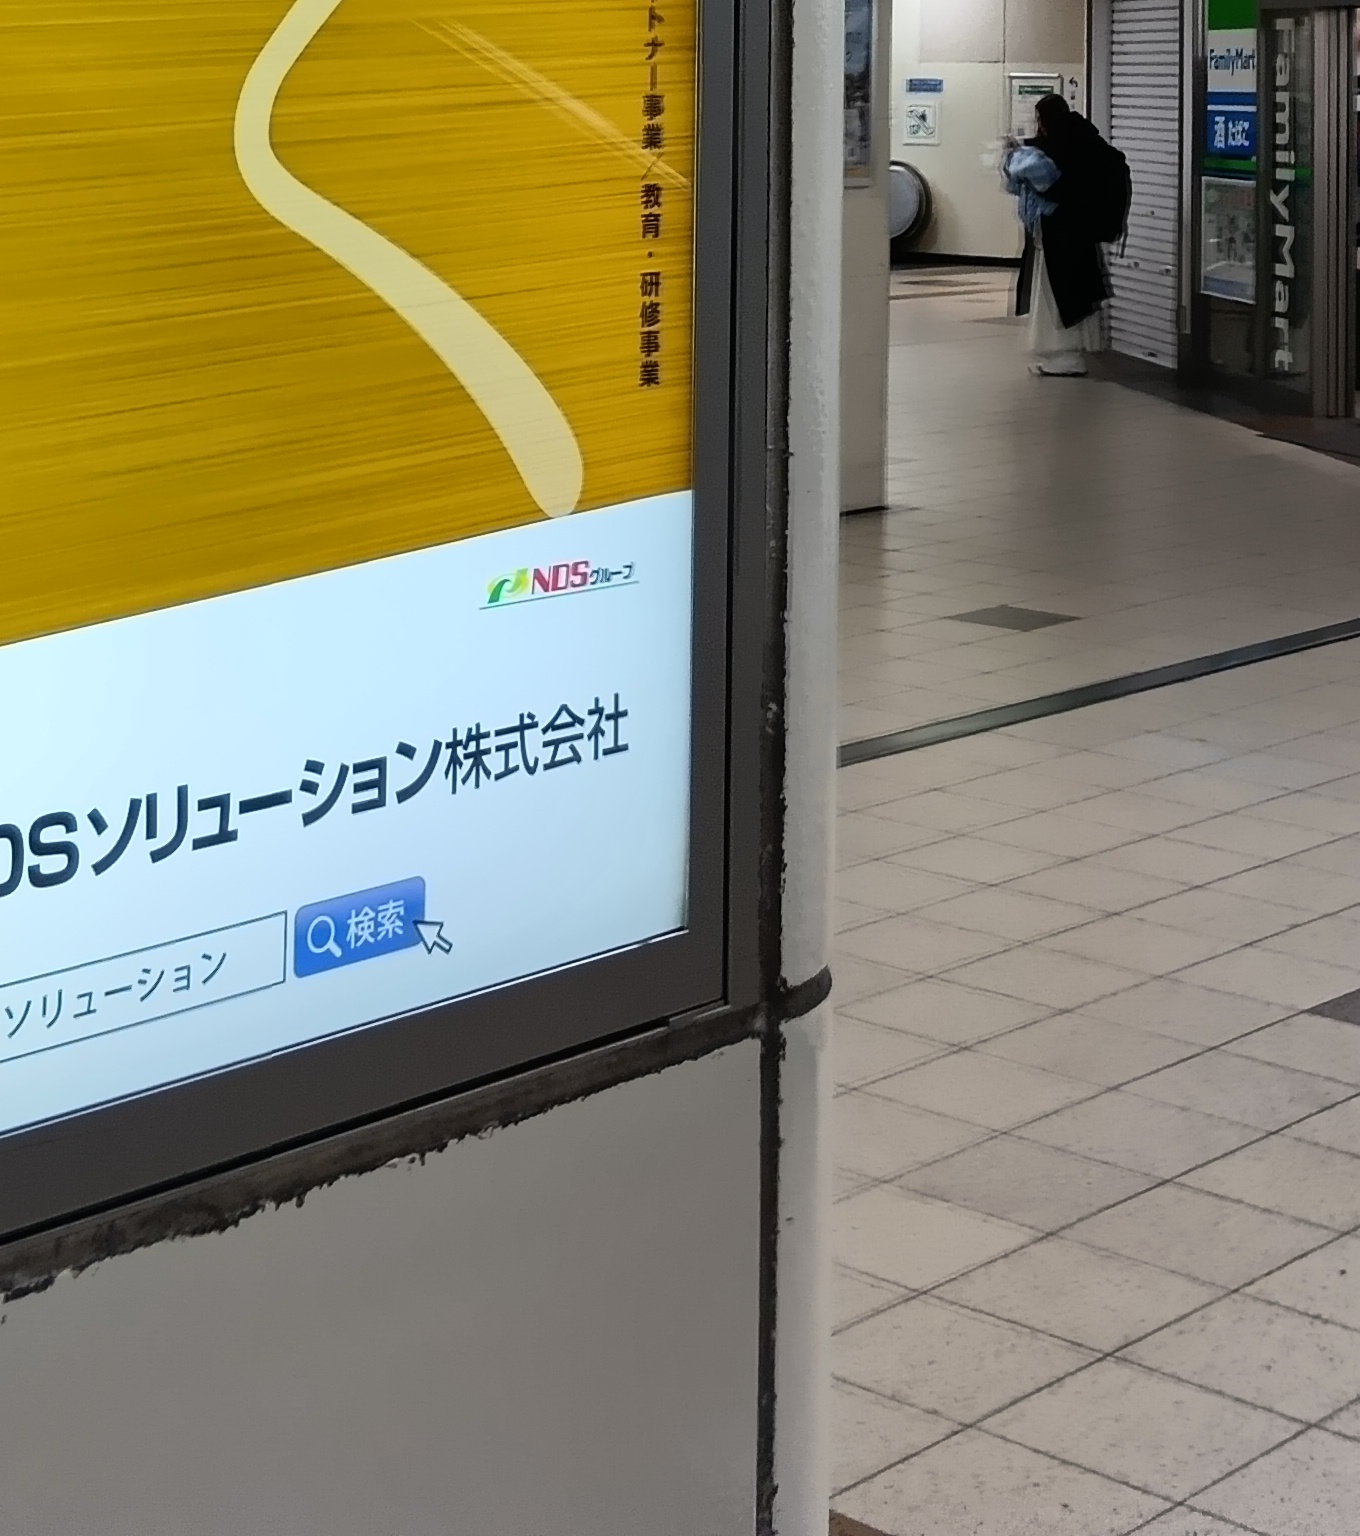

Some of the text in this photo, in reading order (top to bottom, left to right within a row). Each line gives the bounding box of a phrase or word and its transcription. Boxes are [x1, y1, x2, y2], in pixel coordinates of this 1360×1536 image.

[1209, 47, 1256, 76] FamilyMart
[531, 559, 637, 595] NDSグループ
[344, 897, 408, 952] 検索
[3, 945, 229, 1041] ソリューション
